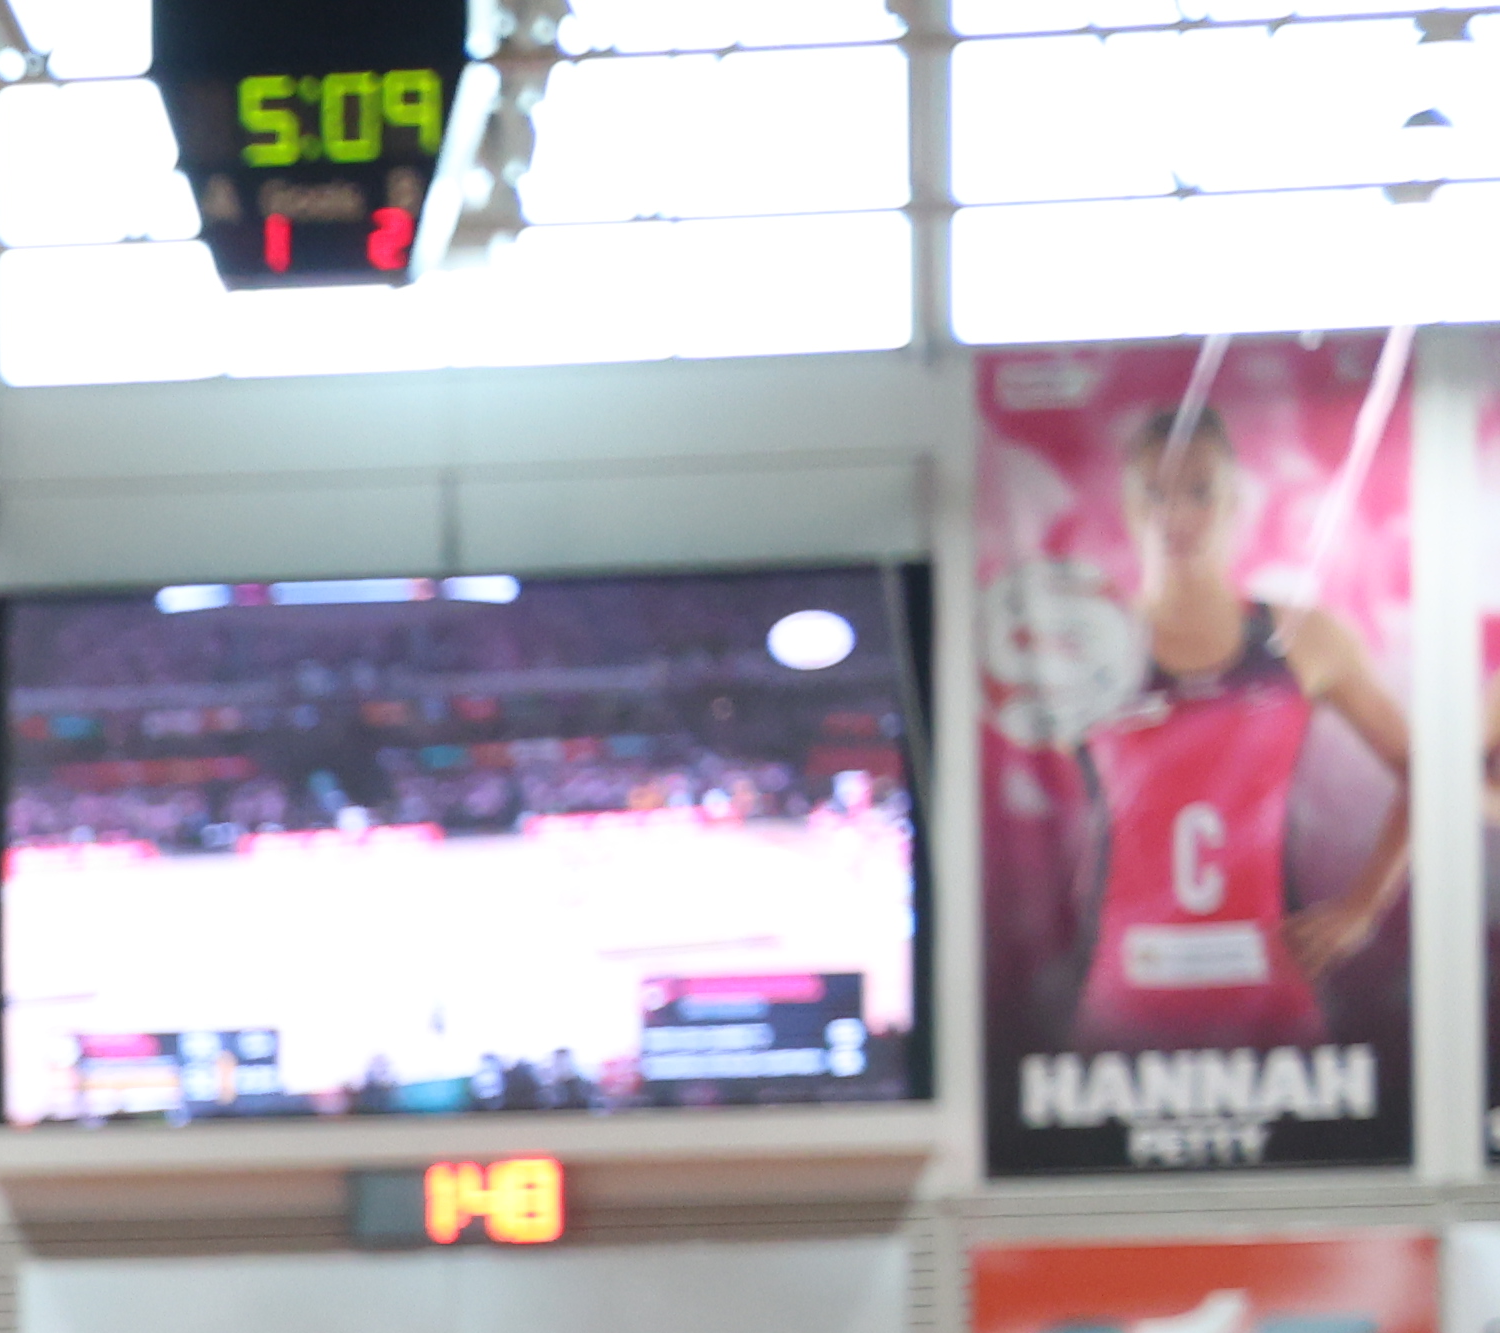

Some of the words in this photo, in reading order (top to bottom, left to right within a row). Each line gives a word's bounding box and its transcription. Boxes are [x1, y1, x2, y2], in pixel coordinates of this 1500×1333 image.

[238, 70, 442, 167] 5:09
[367, 207, 414, 270] 2
[1171, 801, 1227, 914] C
[1021, 1045, 1376, 1128] HANNAH
